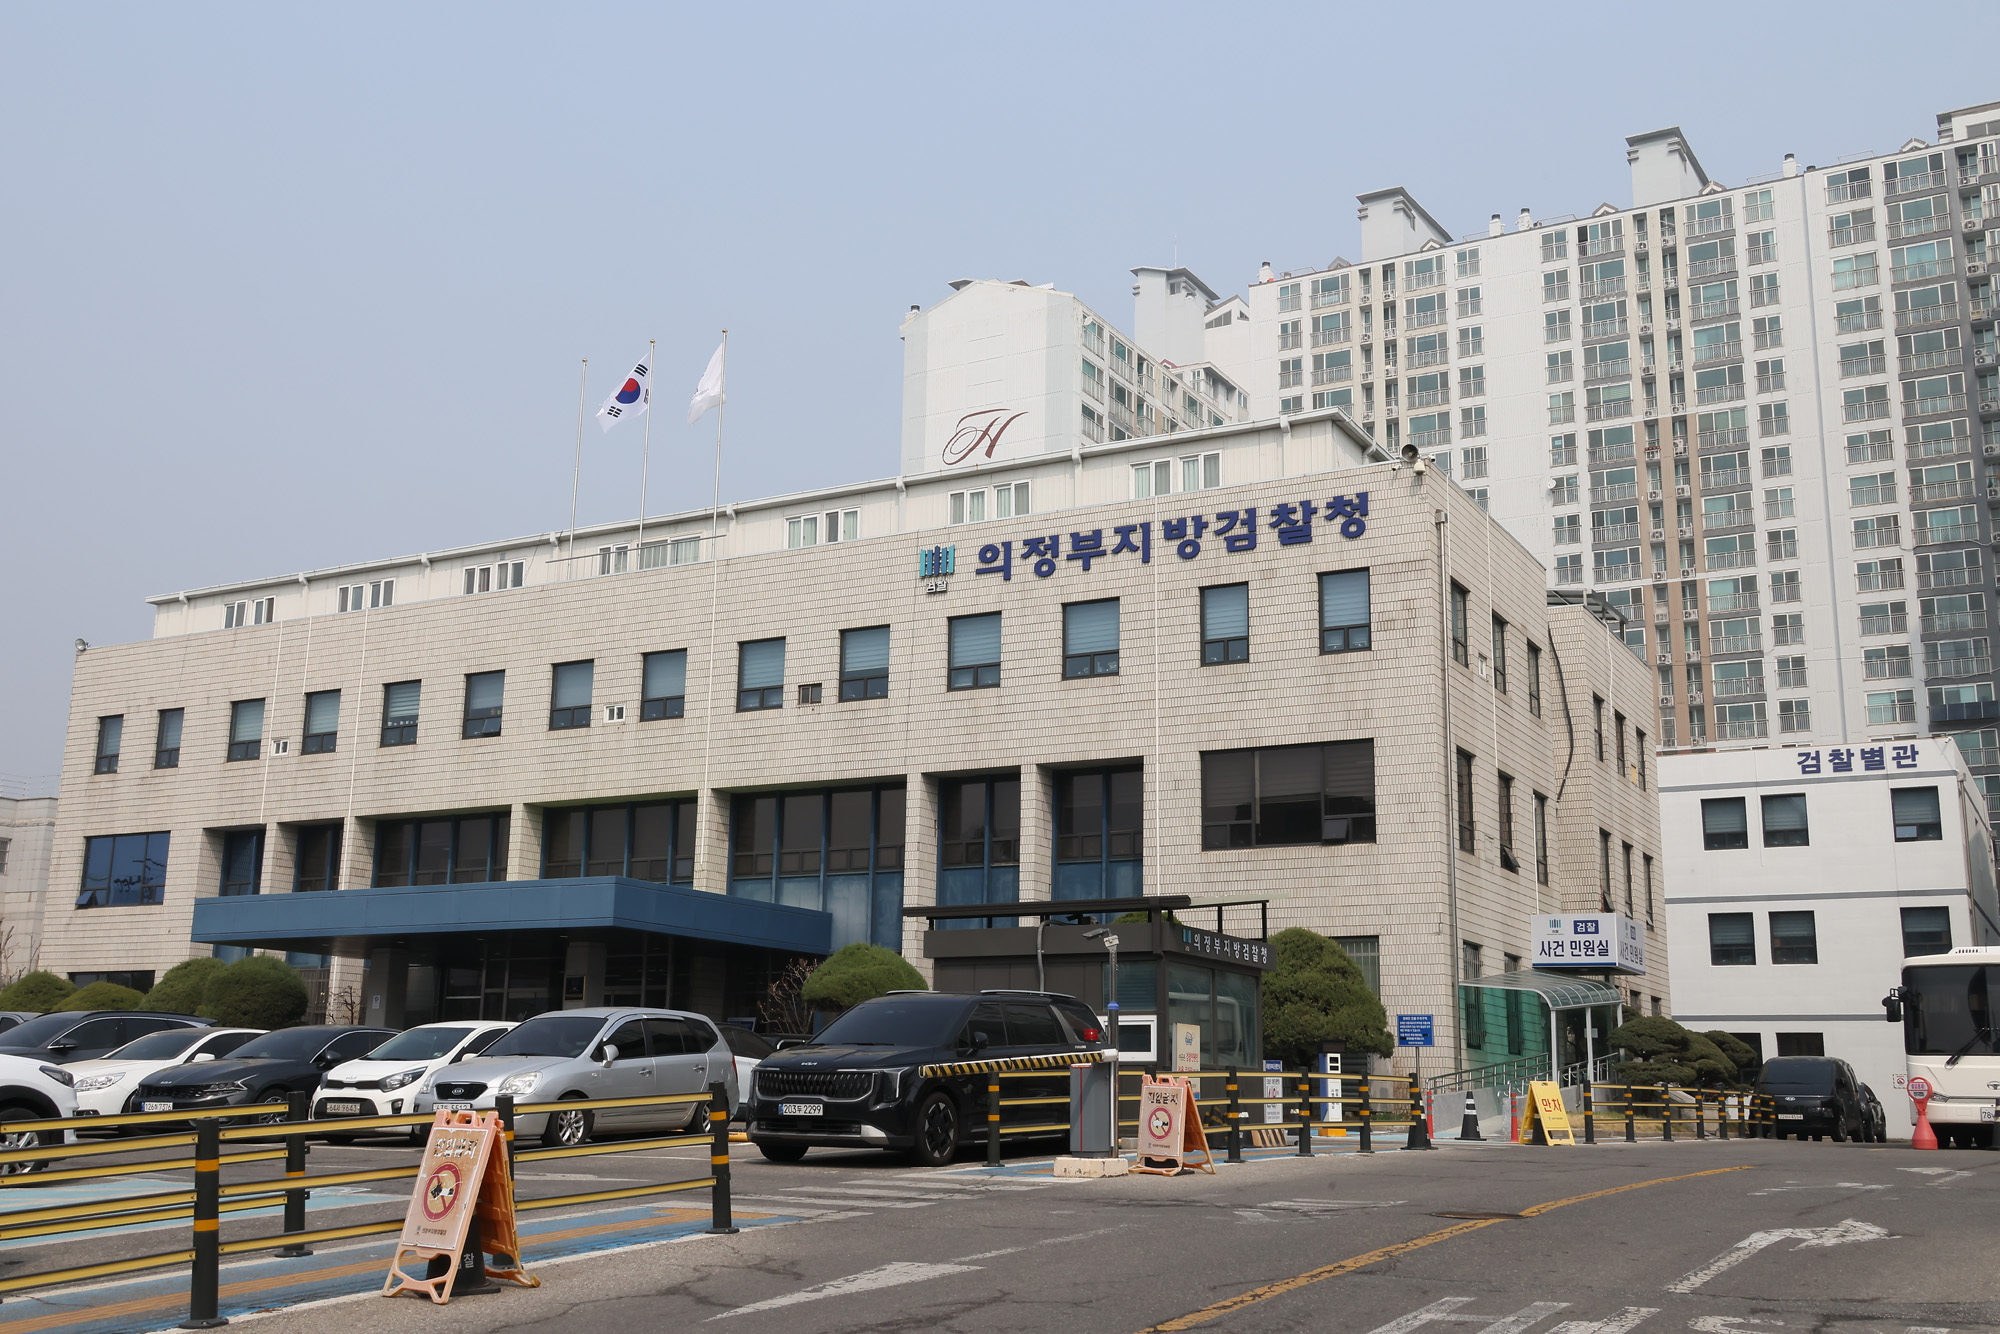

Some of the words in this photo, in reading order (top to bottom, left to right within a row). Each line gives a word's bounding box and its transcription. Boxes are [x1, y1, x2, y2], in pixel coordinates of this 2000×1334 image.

[976, 492, 1370, 581] 의정부지방검찰청
[926, 580, 948, 593] 검찰
[1797, 744, 1919, 775] 검찰별관
[1576, 922, 1596, 933] 검찰
[1193, 933, 1268, 964] 의정부지방검찰청
[1539, 940, 1565, 957] 사건
[1570, 939, 1609, 957] 민원실
[783, 1105, 802, 1114] 203두
[803, 1105, 822, 1114] 2299
[1541, 1098, 1562, 1112] 만차
[459, 1252, 475, 1269] 찰
